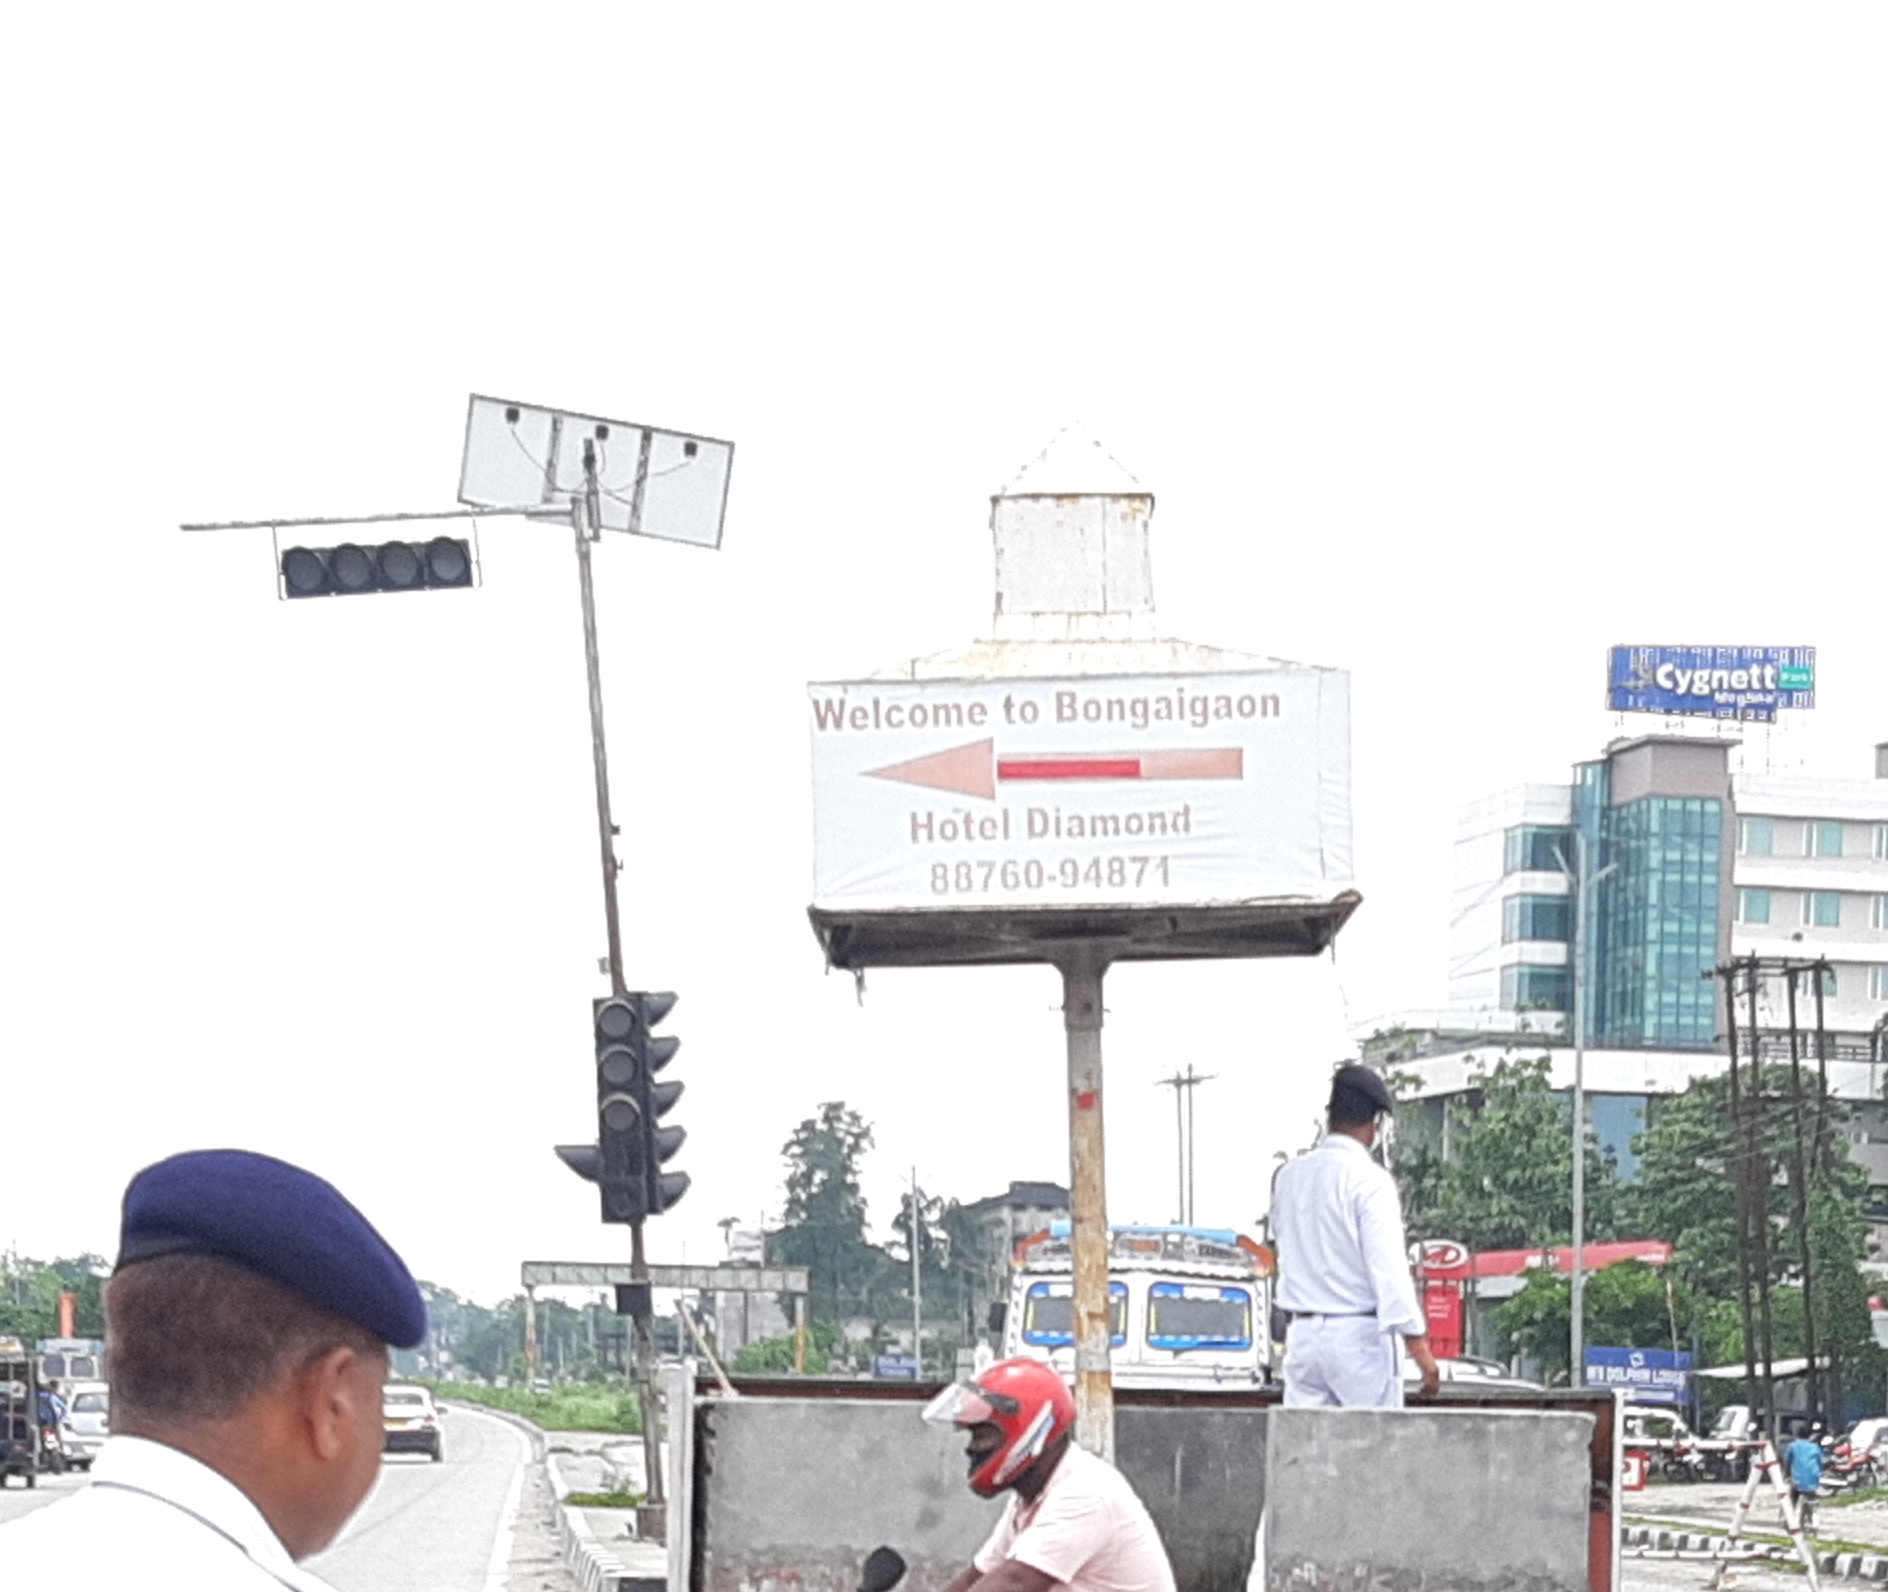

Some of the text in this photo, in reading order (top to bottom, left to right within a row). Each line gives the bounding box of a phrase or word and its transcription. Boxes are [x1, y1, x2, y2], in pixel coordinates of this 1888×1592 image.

[1655, 662, 1776, 696] Cygnett
[812, 687, 1281, 732] Welcome to Bongaigaon
[909, 803, 1192, 844] Hotel Diamond
[929, 854, 1171, 896] 88760-94871
